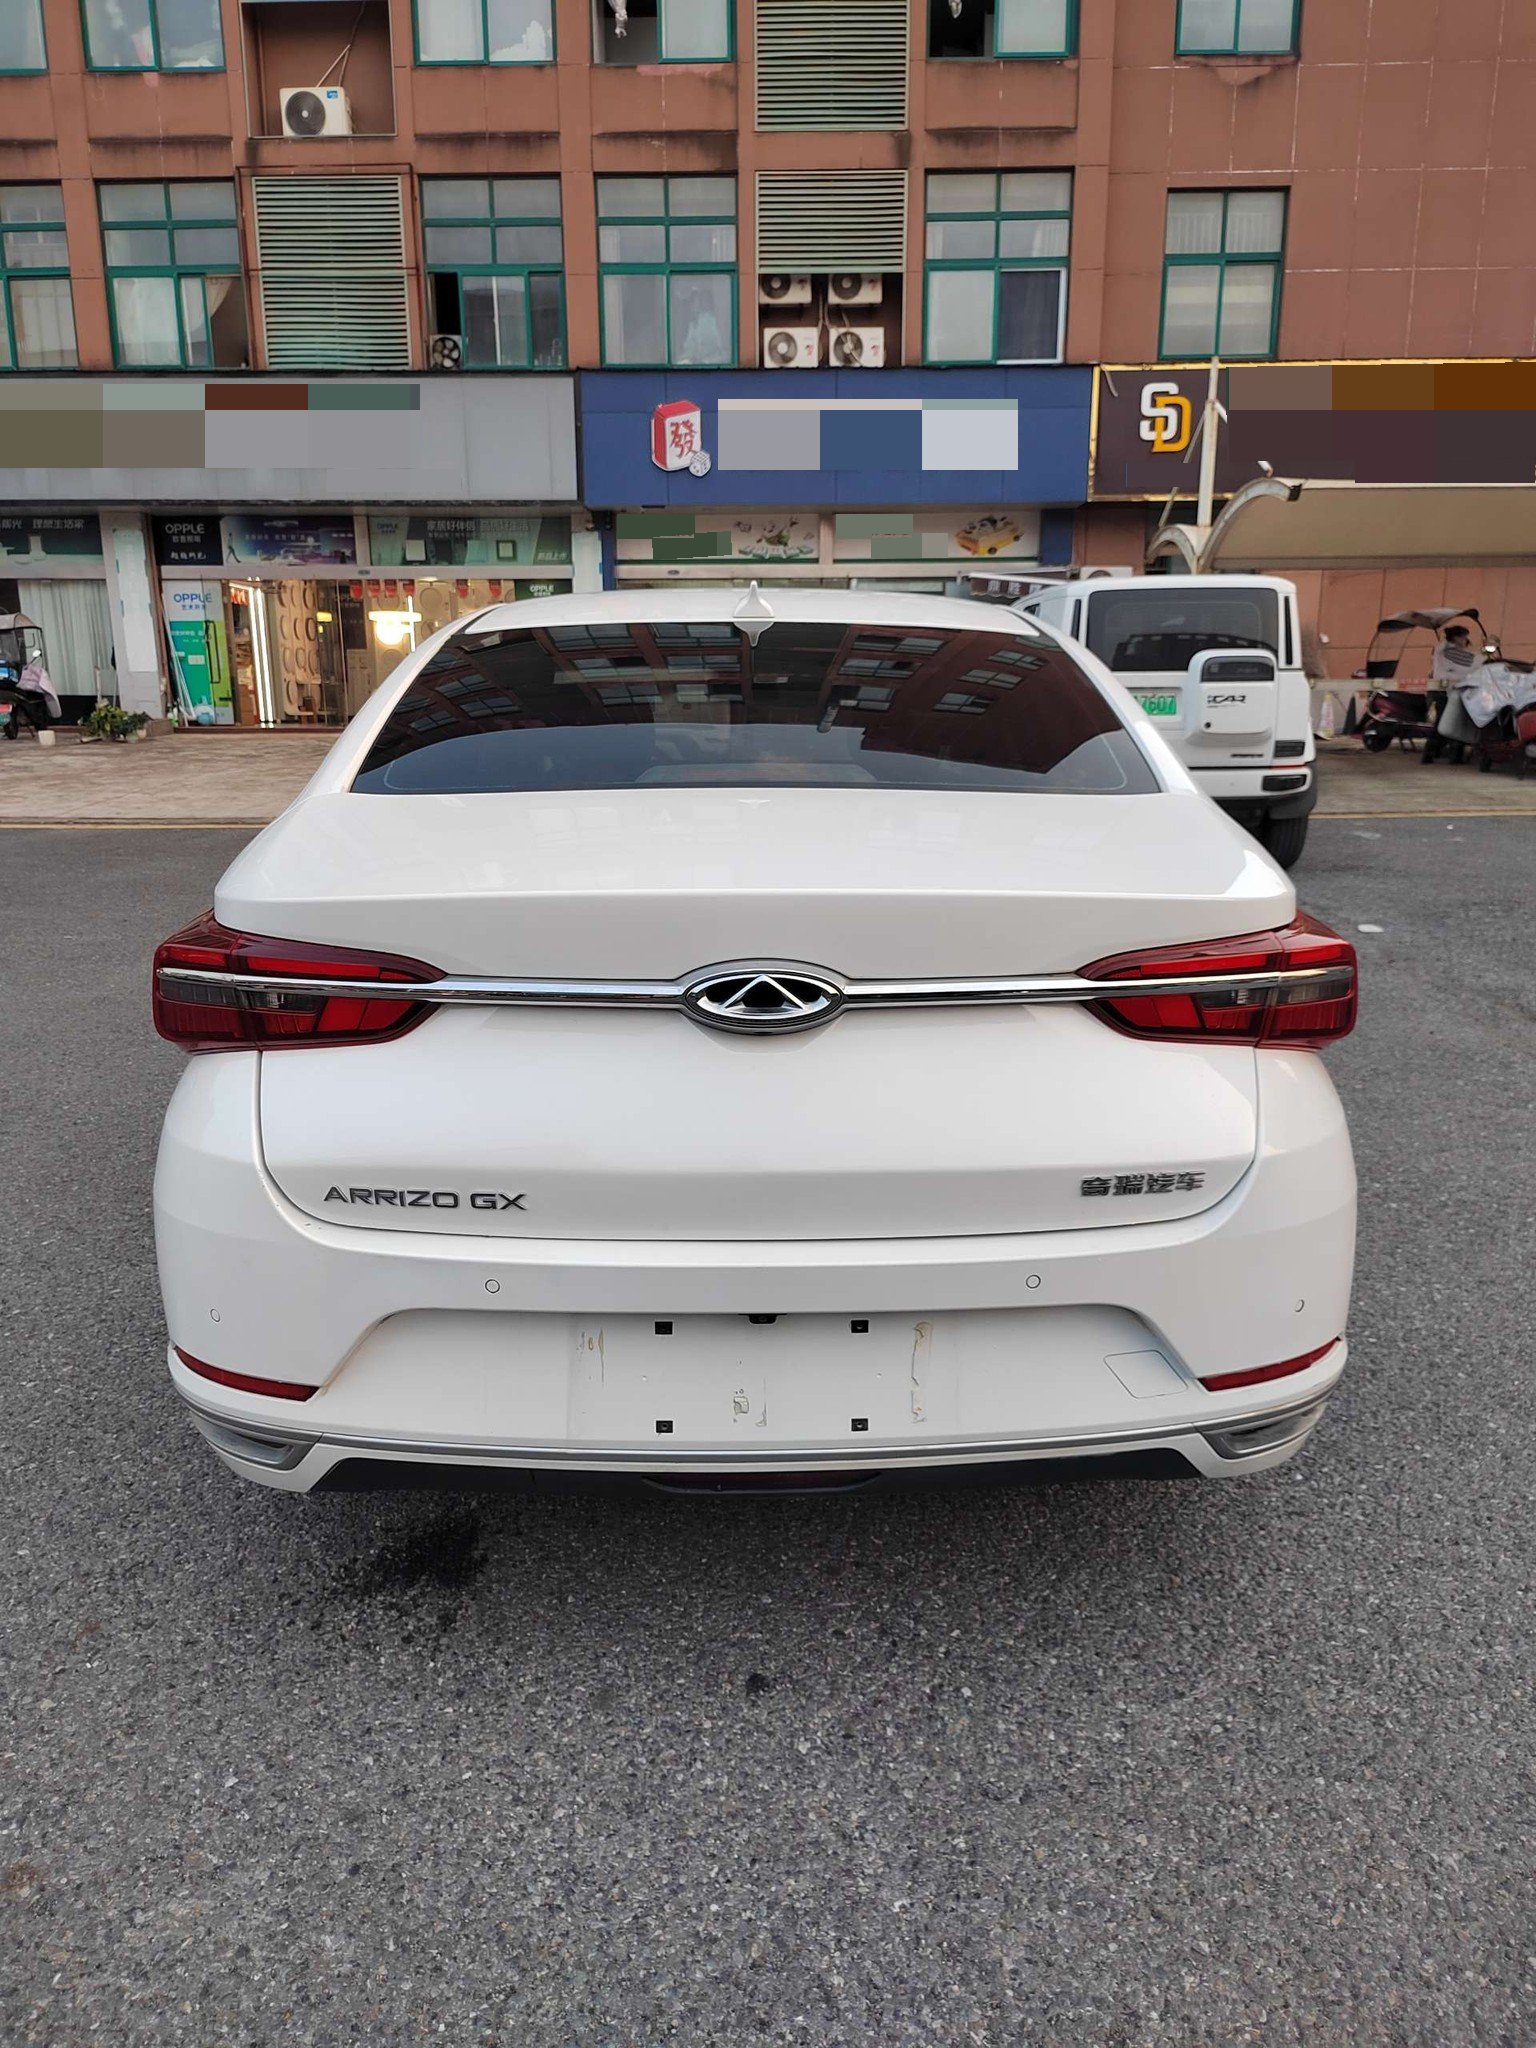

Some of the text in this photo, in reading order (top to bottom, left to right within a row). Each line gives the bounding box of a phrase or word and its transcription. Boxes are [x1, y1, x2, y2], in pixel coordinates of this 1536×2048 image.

[1139, 382, 1191, 453] SD
[670, 419, 698, 459] 發
[165, 523, 205, 534] OPPLE
[173, 593, 213, 603] OPPLE
[1080, 1172, 1206, 1196] 奇瑞汽车
[323, 1185, 528, 1211] ARRIZO GX
